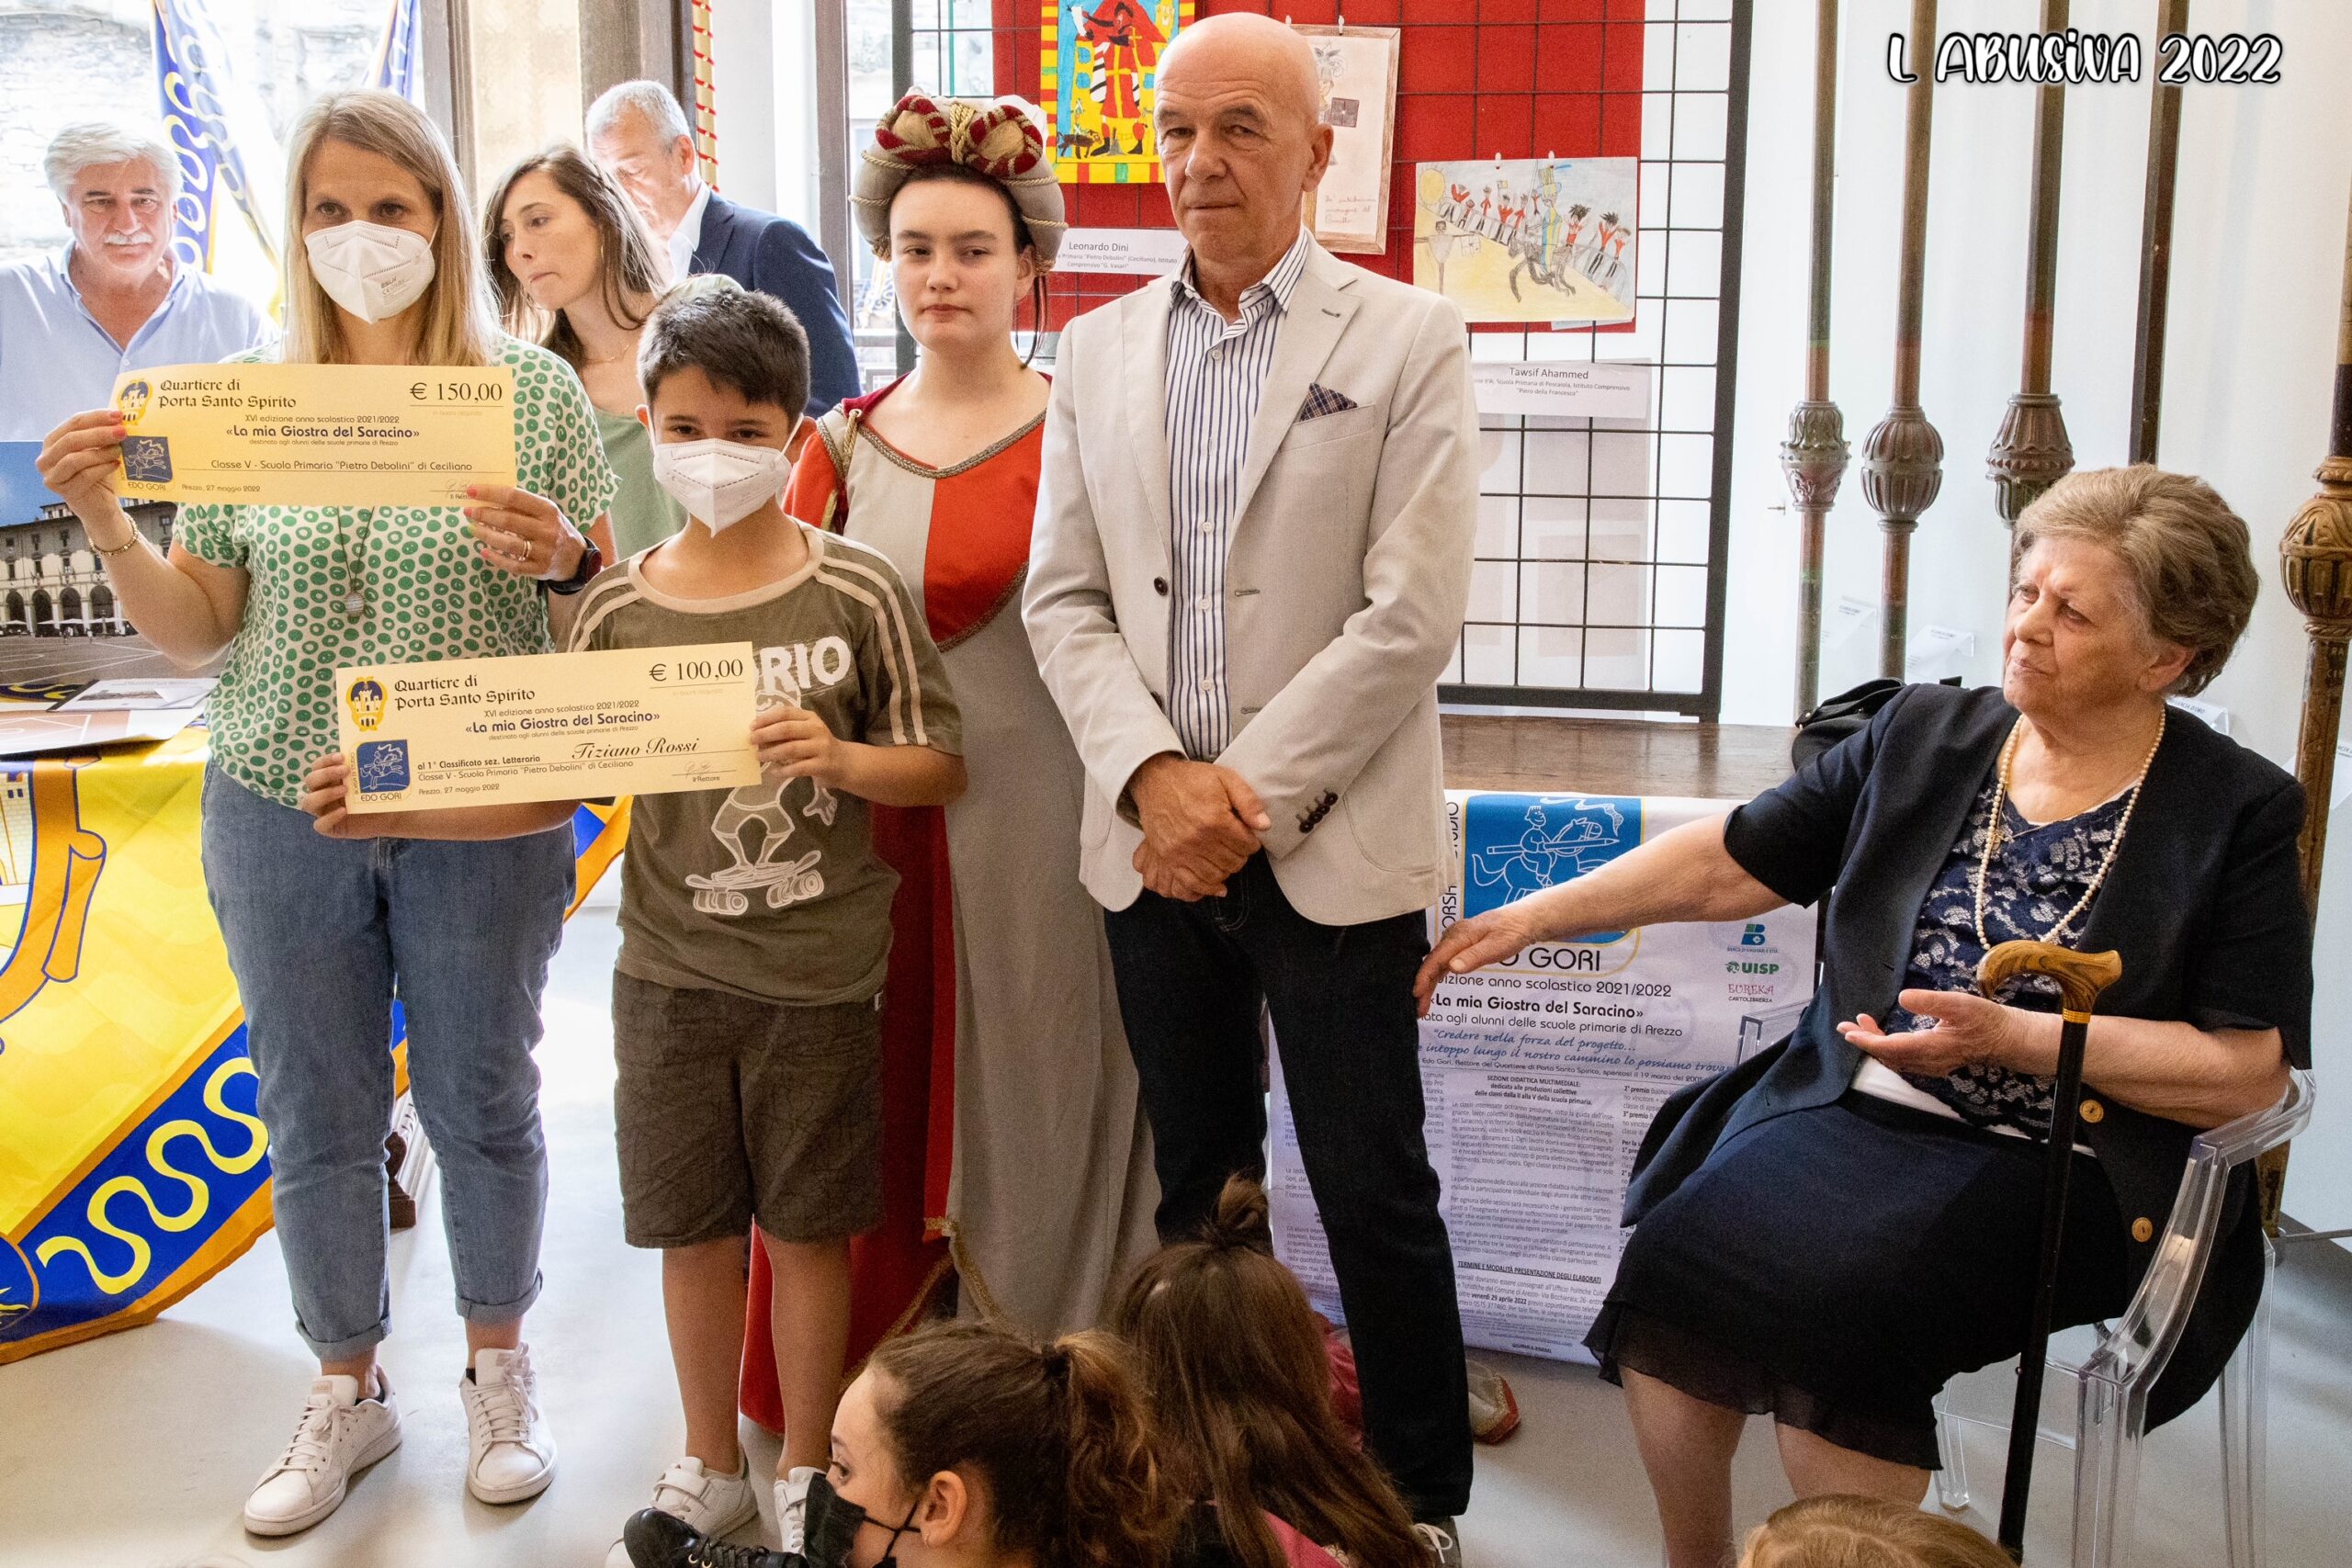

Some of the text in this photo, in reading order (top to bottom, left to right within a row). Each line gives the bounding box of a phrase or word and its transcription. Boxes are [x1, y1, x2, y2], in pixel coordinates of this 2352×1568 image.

[1069, 243, 1129, 252] Leonardo Dini
[1510, 367, 1589, 379] Tawsif Ahammed
[160, 378, 241, 391] Quartiere di
[410, 382, 503, 403] € 150,00
[1594, 384, 1630, 392] Comprensivo
[158, 395, 297, 410] Porta Santo Spirito
[245, 414, 258, 423] XVI
[259, 414, 293, 423] edizione
[317, 415, 356, 423] scolastico
[356, 415, 400, 423] 2021/2022
[226, 425, 420, 438] «La mia Giostra del Saracino»
[210, 460, 472, 471] Classe V Scuola Primaria "Pietro Debolini" di Ceciliano
[128, 482, 166, 491] EDO GORI
[217, 485, 242, 493] maggio
[649, 659, 743, 682] € 100,00
[753, 636, 852, 694] RIO
[394, 675, 478, 693] Quartiere di
[394, 689, 536, 711] Porta Santo Spirito
[499, 708, 533, 717] edizione
[535, 706, 554, 715] anno
[556, 704, 594, 713] scolastico
[596, 700, 639, 710] 2021/2022
[466, 710, 661, 733] «La mia Giostra del Saracino»
[571, 737, 700, 760] Tiziano Rossi
[439, 759, 482, 769] Classificato
[484, 759, 500, 767] sez.
[503, 755, 540, 764] Letteraria
[419, 760, 634, 782] Classe V Scuola Primaria "Pietro Debolini" di Ceciliano
[360, 793, 402, 802] EDO GORI
[419, 787, 443, 795] Arezzo,
[444, 786, 453, 795] 27
[455, 784, 481, 795] maggio
[1529, 947, 1600, 971] GORI
[1742, 963, 1780, 975] UISP
[1488, 977, 1521, 987] anno
[1525, 978, 1591, 992] scolastico
[1596, 981, 1672, 998] 2021/2022
[1728, 984, 1775, 995] EUREKA
[1456, 995, 1483, 1009] mia
[1487, 997, 1541, 1012] Giostra
[1545, 999, 1568, 1014] del
[1573, 1001, 1644, 1019] Saracino»
[1447, 1013, 1467, 1026] agli
[1471, 1014, 1505, 1026] alunni
[1508, 1016, 1537, 1028] delle
[1540, 1020, 1576, 1031] scuole
[1579, 1021, 1627, 1033] primarie
[1630, 1024, 1642, 1034] di
[1645, 1024, 1683, 1037] Arezzo
[1484, 1031, 1515, 1043] nella
[1517, 1033, 1550, 1051] forza
[1555, 1036, 1575, 1047] del
[1577, 1039, 1636, 1054] progetto...
[1426, 1043, 1692, 1070] intoppo lungo il nostro cammino lo possiamo
[1455, 1059, 1480, 1067] Rettore
[1494, 1062, 1526, 1070] Quartiere
[1651, 1073, 1671, 1081] marzo
[1510, 1076, 1538, 1085] DIDATTICA
[1539, 1077, 1581, 1088] MULTIMEDIALE:
[1458, 1261, 1481, 1270] TERMINE
[1487, 1263, 1513, 1274] MODALITÀ
[1514, 1267, 1555, 1279] PRESENTAZIONE
[1556, 1270, 1572, 1280] DEGLI
[1573, 1272, 1601, 1284] ELABORATI
